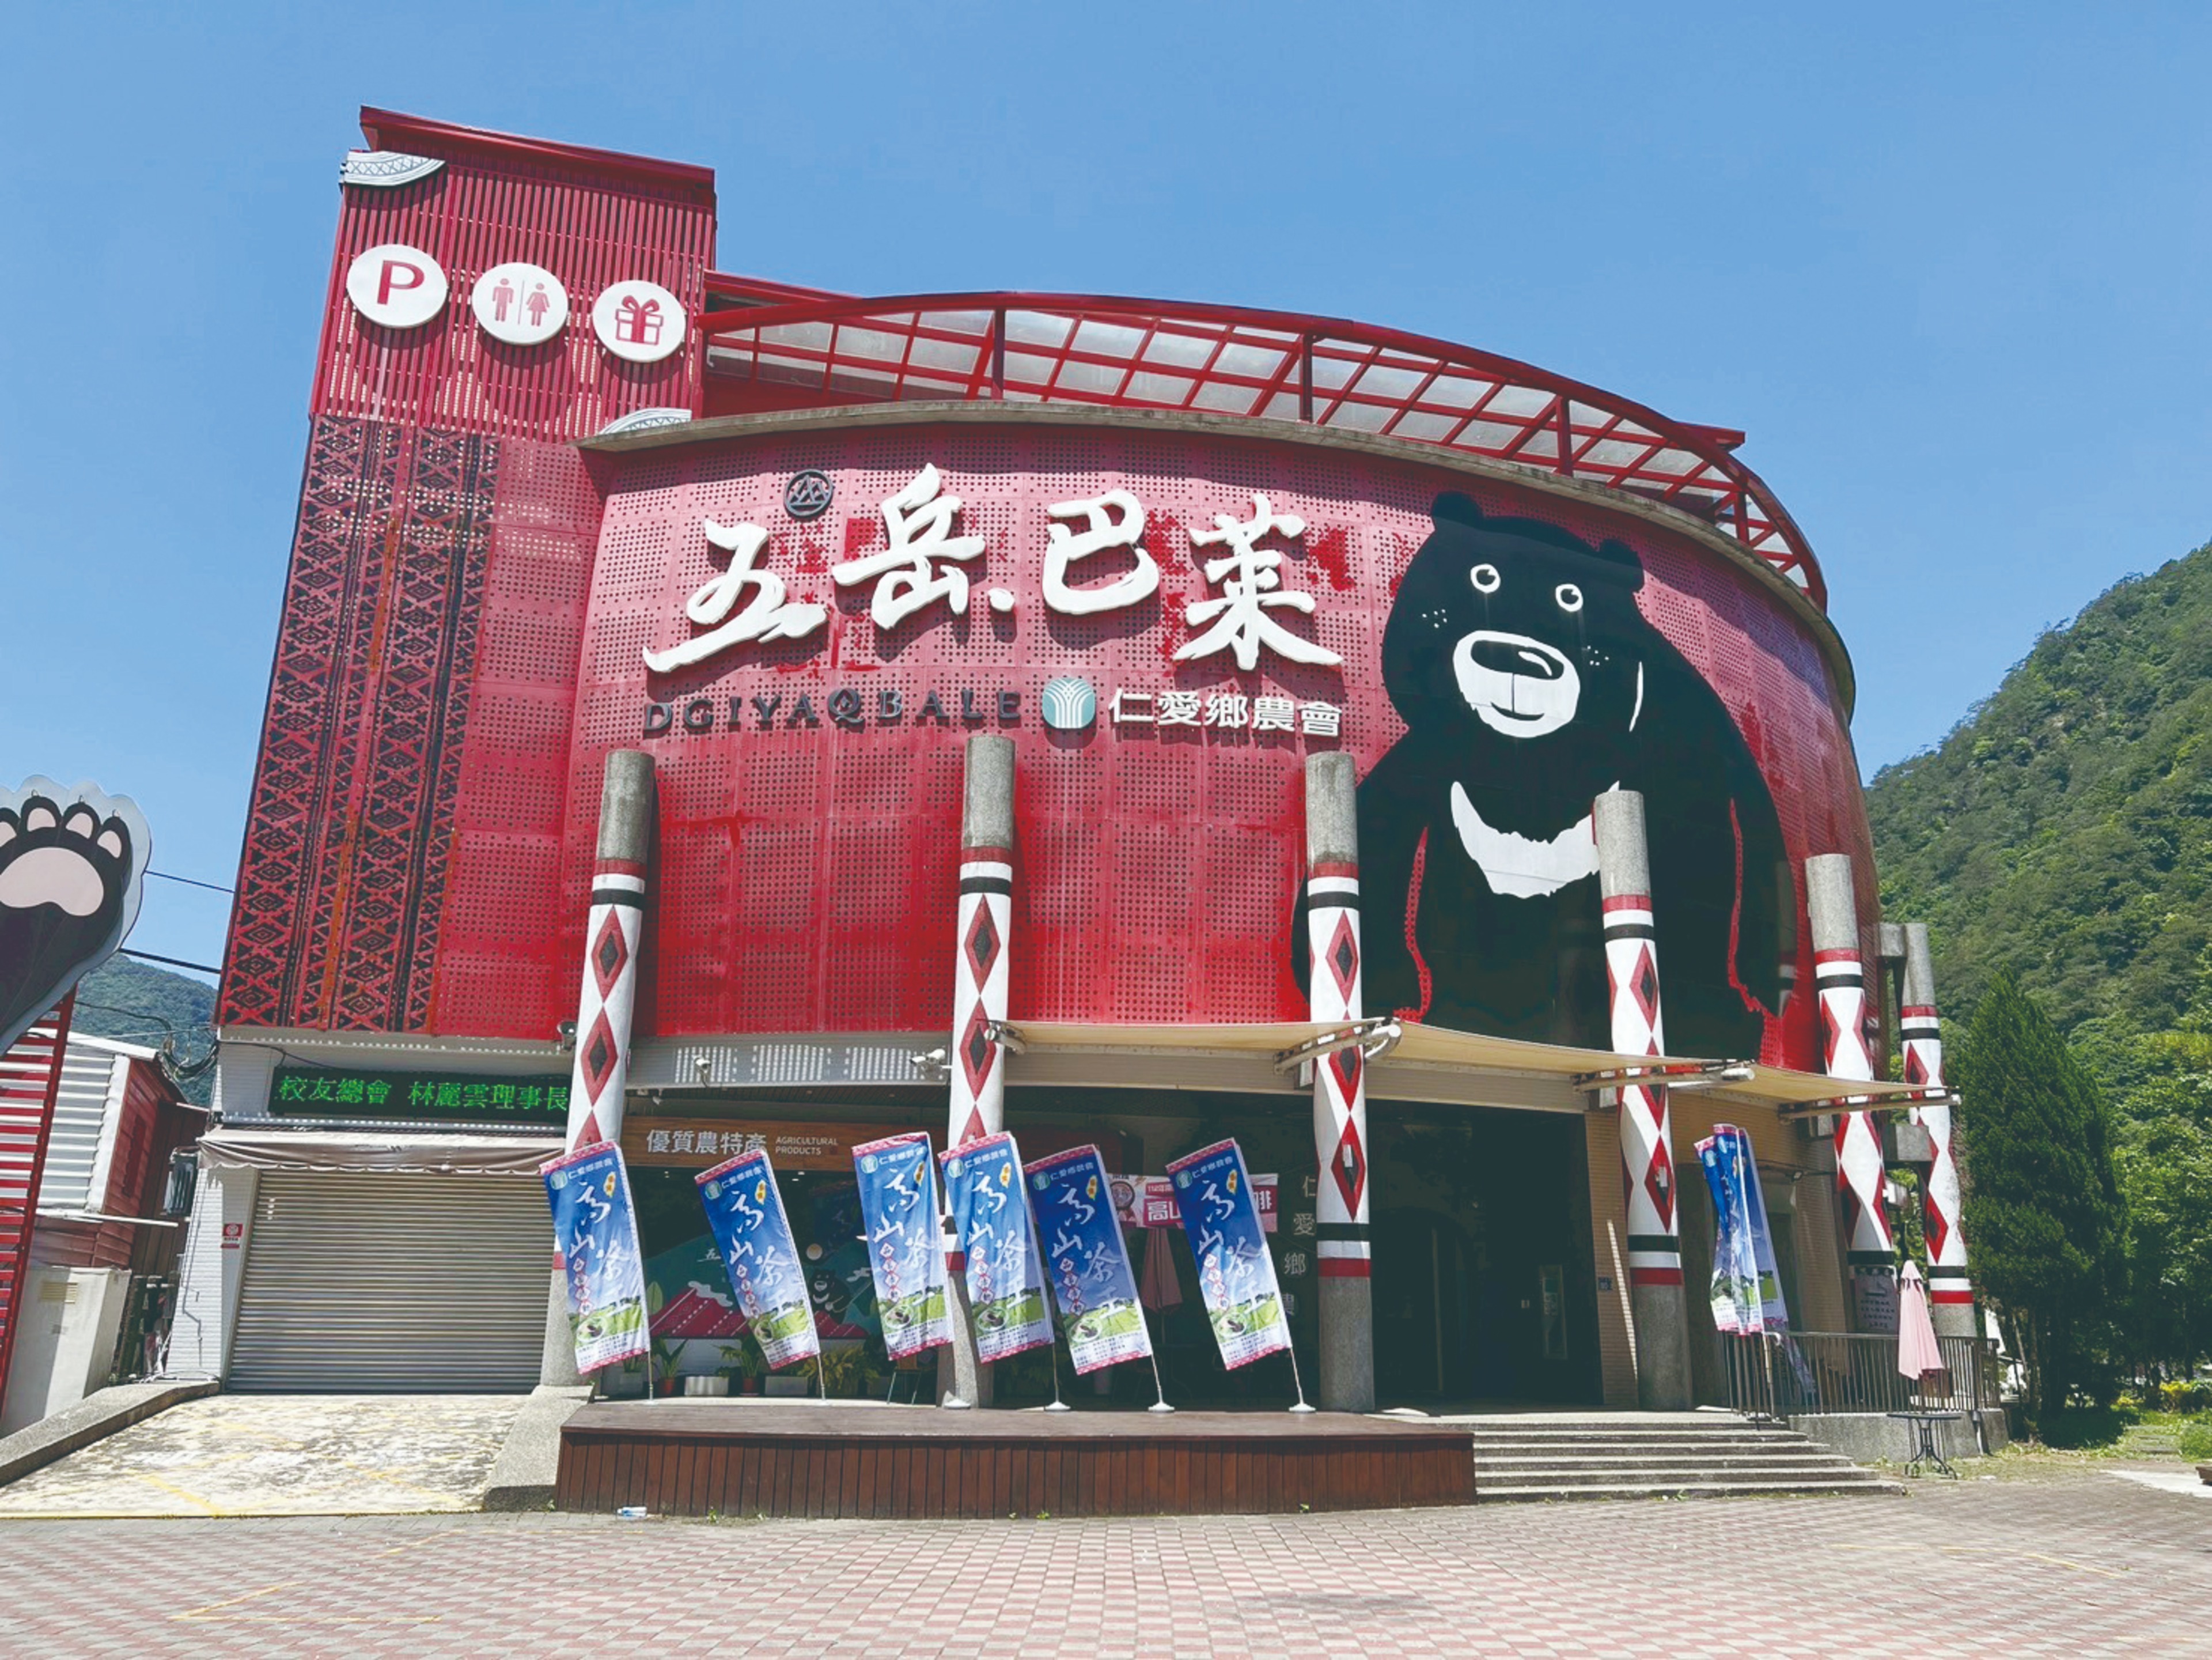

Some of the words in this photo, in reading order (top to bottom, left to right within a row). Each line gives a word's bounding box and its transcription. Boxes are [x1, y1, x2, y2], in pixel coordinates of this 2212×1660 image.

[377, 260, 425, 305] P
[1108, 688, 1342, 738] 仁愛鄉農會
[279, 1076, 392, 1105] 校友總會
[407, 1081, 568, 1111] 林麗雲理事長
[646, 1129, 767, 1155] 優質農特產
[775, 1136, 838, 1146] AGRICULTURAL
[775, 1146, 821, 1155] PRODUCTS
